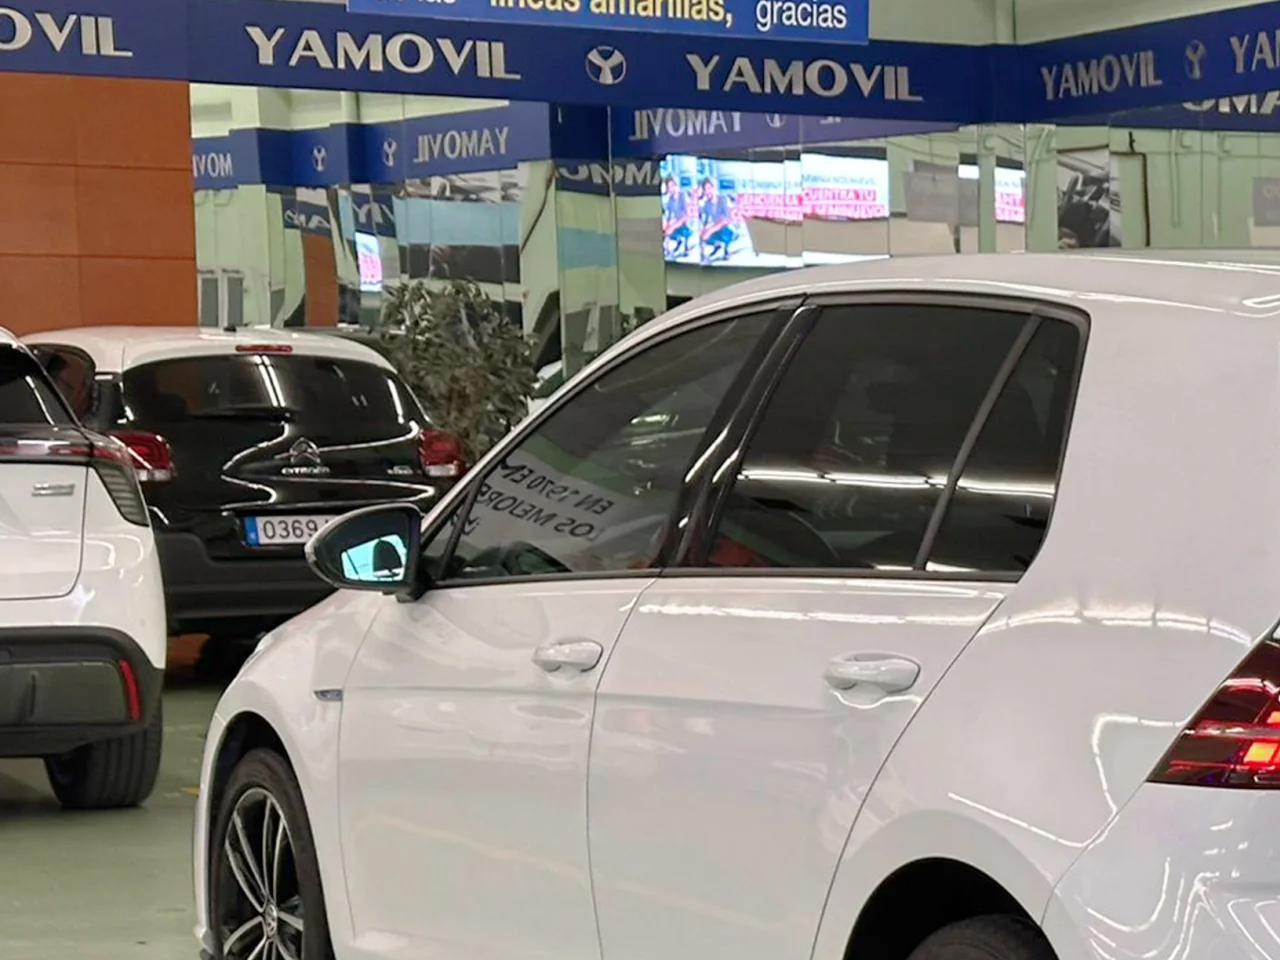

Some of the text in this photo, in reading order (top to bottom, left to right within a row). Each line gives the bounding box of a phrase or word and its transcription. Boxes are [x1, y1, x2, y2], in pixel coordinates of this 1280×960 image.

[756, 0, 848, 32] gracias
[247, 26, 521, 80] YAMOVIL
[686, 53, 923, 101] YAMOVIL
[1040, 50, 1163, 100] YAMOVIL
[262, 518, 318, 540] 0369
